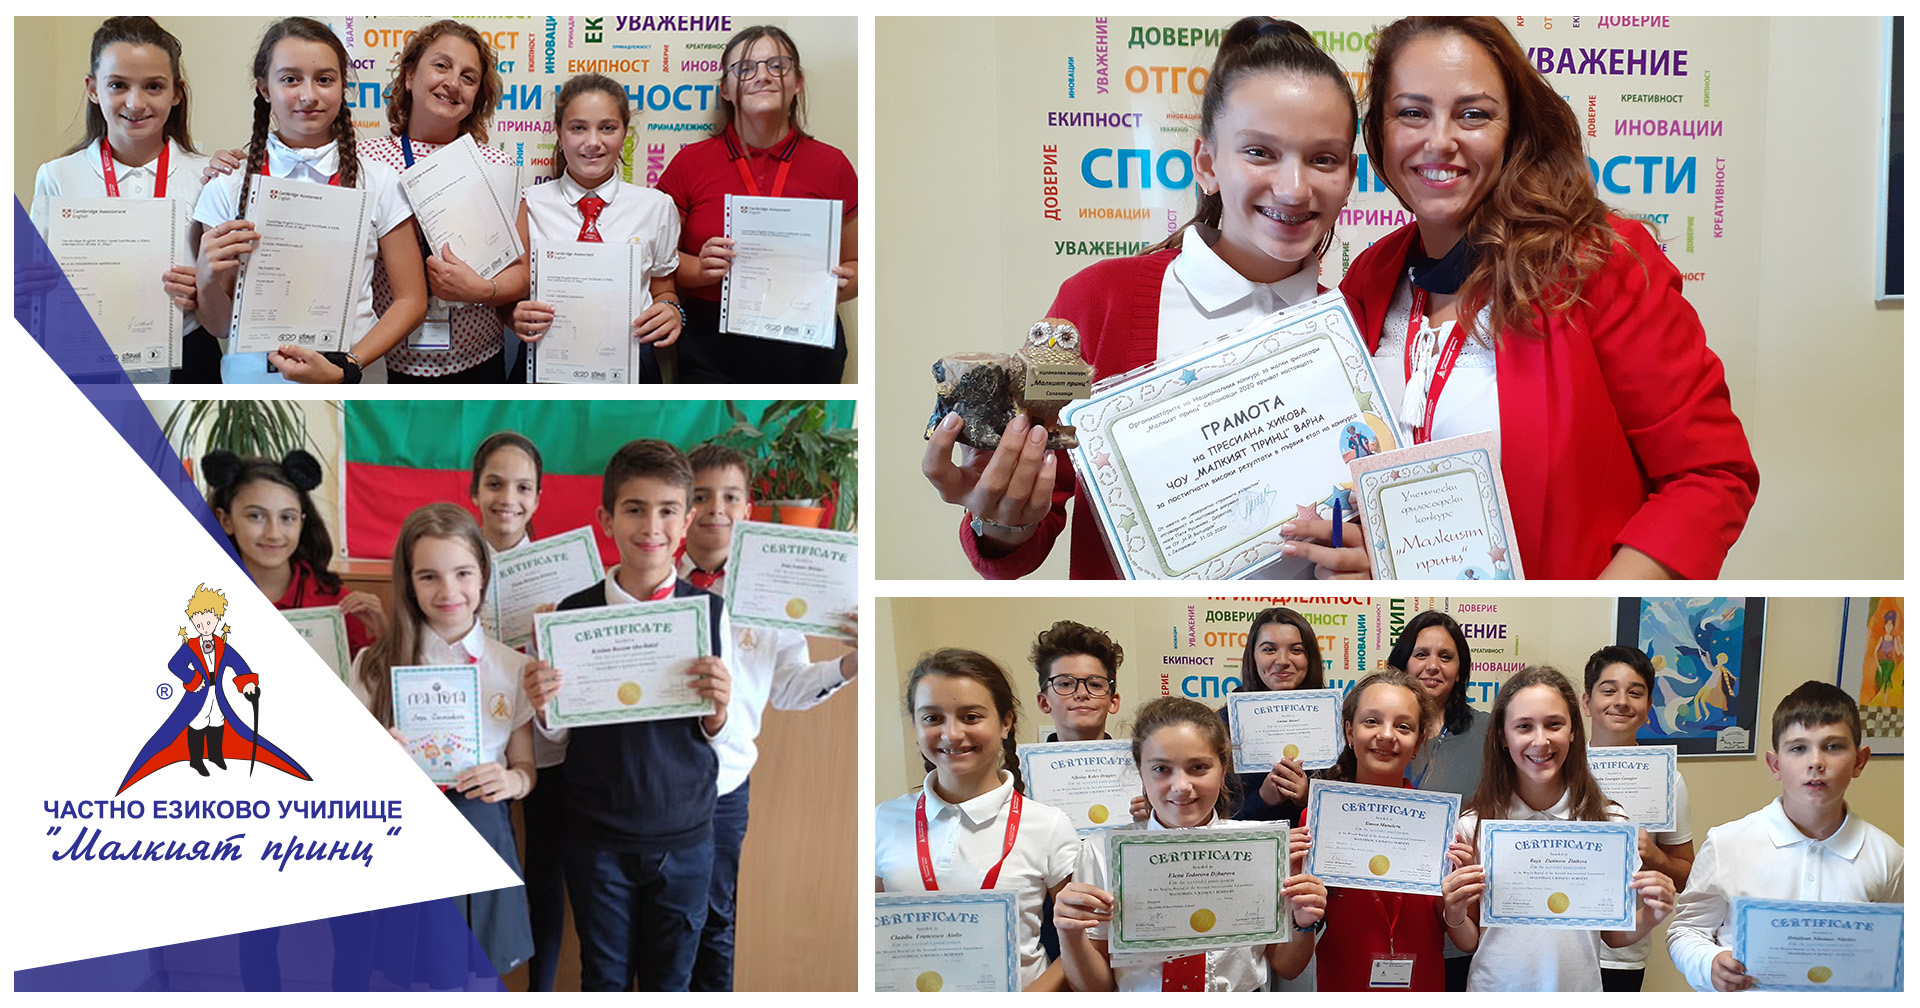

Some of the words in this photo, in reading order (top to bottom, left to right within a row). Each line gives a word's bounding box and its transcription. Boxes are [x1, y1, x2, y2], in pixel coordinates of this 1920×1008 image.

[616, 16, 732, 31] УВАЖЕНИЕ
[1598, 16, 1670, 29] ДОВЕРИЕ
[1096, 17, 1108, 94] УВАЖЕНИЕ
[568, 59, 650, 73] ЕКИПНОСТ
[1621, 94, 1683, 103] КРЕАТИВНОСТ
[1048, 112, 1143, 128] ЕКИПНОСТ
[1588, 95, 1597, 137] ДОВЕРИЕ
[1614, 119, 1723, 140] ИНОВАЦИИ
[1043, 144, 1061, 221] ДОВЕРИЕ
[1714, 157, 1725, 238] КРЕАТИВНОСТ
[1079, 208, 1150, 221] ИНОВАЦИИ
[1239, 383, 1255, 393] 2020
[1200, 395, 1285, 441] ГРАМОТА
[1192, 453, 1205, 464] на
[1207, 426, 1265, 456] ПРЕСИАНА
[1267, 406, 1307, 430] ХИКОВА
[1166, 474, 1189, 491] ЧОУ
[1293, 414, 1325, 433] ВАРНА
[1168, 481, 1209, 505] постигнати
[1211, 470, 1236, 484] високи
[1401, 495, 1464, 515] философски
[1414, 510, 1454, 524] конкурс
[761, 543, 848, 563] CERTIFICATE
[1458, 604, 1498, 613] ДОВЕРИЕ
[574, 622, 673, 642] CERTIFICATE
[1188, 605, 1196, 647] УВАЖЕНИЕ
[1358, 614, 1367, 671] ИНОВАЦИИ
[1163, 656, 1214, 665] ЕКИПНОСТ
[1253, 704, 1319, 715] CERTIFICATE
[1050, 756, 1132, 770] CERTIFICATE
[1341, 801, 1427, 820] CERTIFICATE
[1514, 838, 1603, 852] CERTIFICATE
[1149, 849, 1253, 865] CERTIFICATE
[1771, 918, 1874, 931] CERTIFICATE
